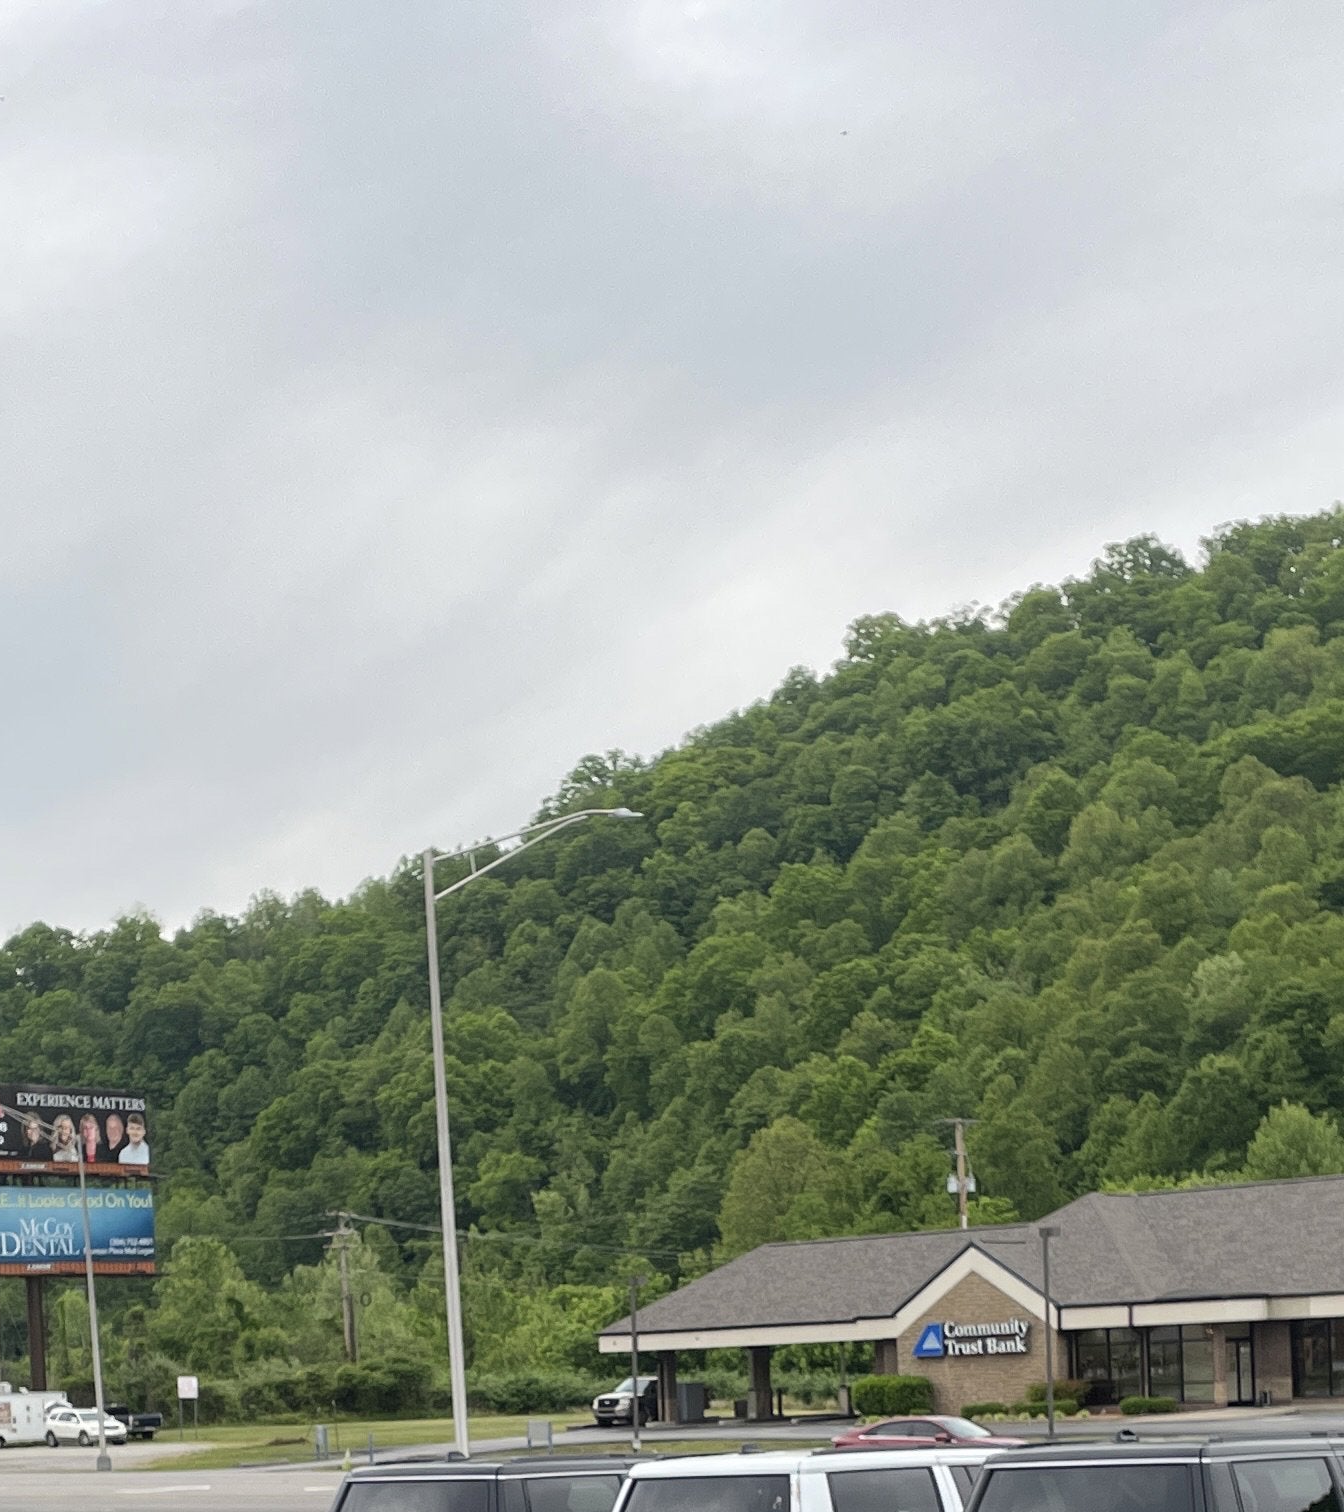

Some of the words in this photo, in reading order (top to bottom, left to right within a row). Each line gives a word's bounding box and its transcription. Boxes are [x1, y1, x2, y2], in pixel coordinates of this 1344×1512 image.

[16, 1092, 90, 1109] EXPERIENCE
[92, 1096, 146, 1111] MATTERS
[105, 1192, 126, 1209] On
[0, 1230, 81, 1257] DENTAL
[943, 1317, 1029, 1338] Community
[944, 1339, 984, 1356] Trust
[986, 1335, 1027, 1353] Bank
